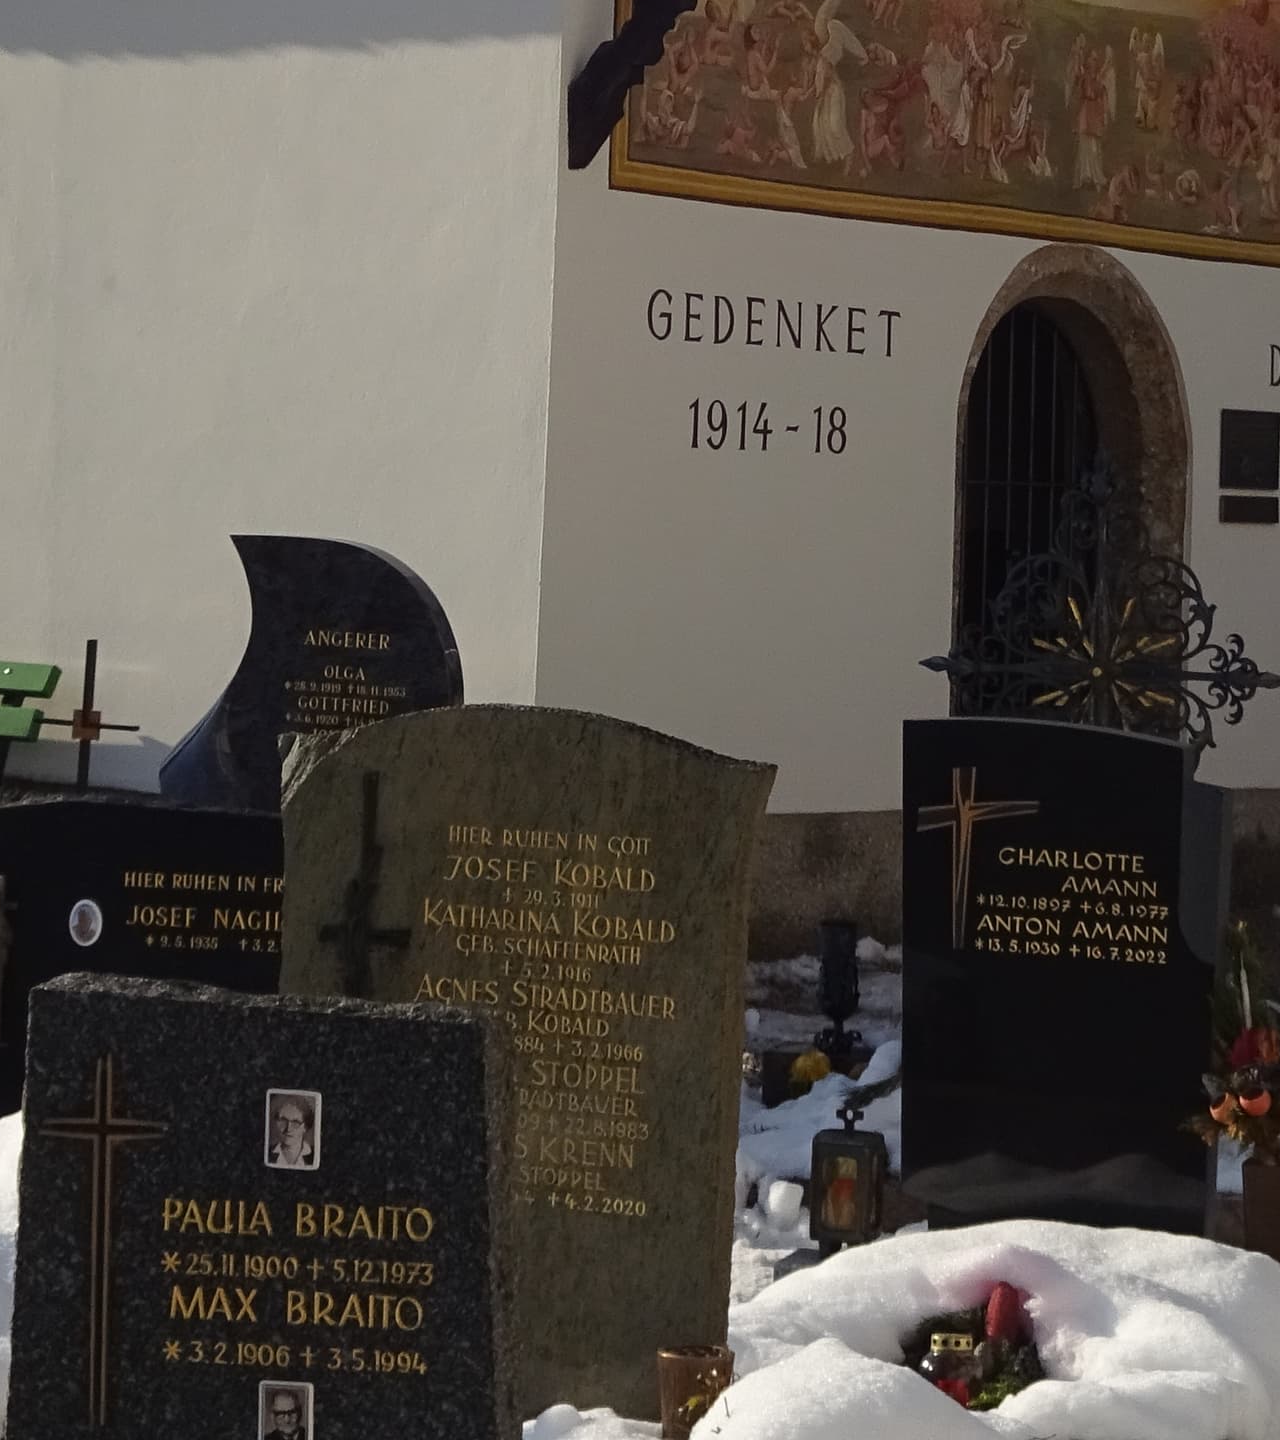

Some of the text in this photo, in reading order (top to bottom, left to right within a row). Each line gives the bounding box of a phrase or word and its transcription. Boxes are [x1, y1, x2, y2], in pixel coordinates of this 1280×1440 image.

[647, 288, 902, 357] GEDENKET
[304, 629, 390, 650] ANGERER
[323, 664, 366, 681] OLGA
[297, 696, 390, 715] GOTTFRIED
[448, 825, 652, 858] HIER RUHEN IN GOTT
[442, 855, 656, 893] JOSEF KOBALD
[998, 846, 1145, 874] CHARLOTTE
[124, 871, 284, 894] HIER RUHEN IN FR
[1060, 876, 1158, 899] AMANN
[125, 905, 199, 929] JOSEF
[423, 897, 676, 944] KATHARINA KOBALD
[977, 913, 1169, 945] ANTON AMANN
[503, 938, 642, 966] SCHAFFENRATH
[414, 973, 677, 1021] AGNES STRADTBAUER
[527, 1009, 611, 1038] KOBALD
[531, 1059, 646, 1095] STOPPEL
[540, 1135, 635, 1170] KRENN
[162, 1197, 434, 1243] PAULA BRAITO
[169, 1283, 425, 1333] MAX BRAITO
